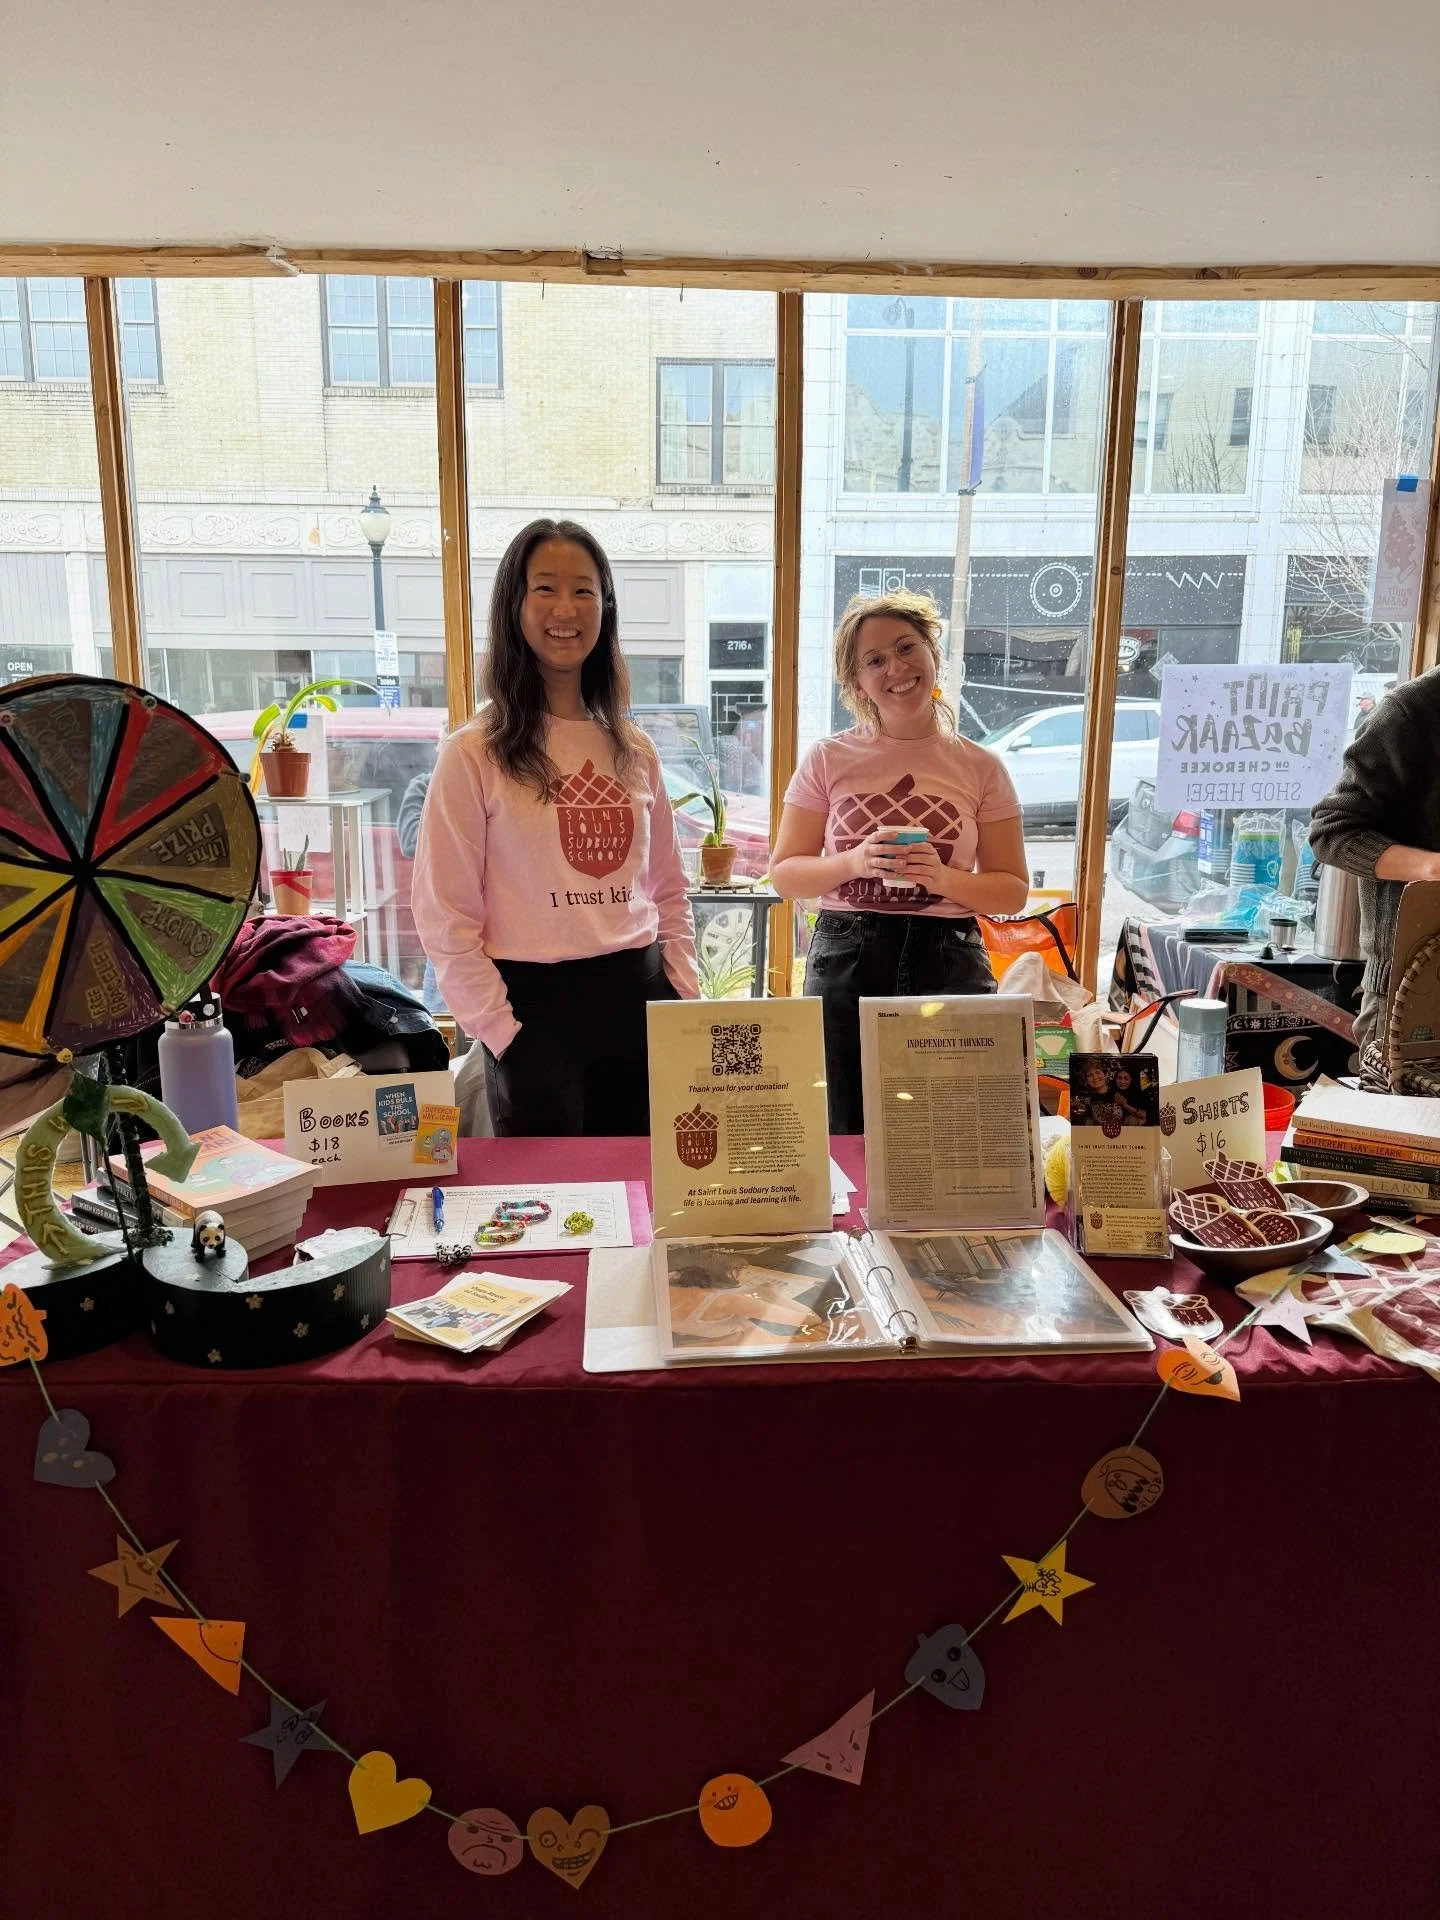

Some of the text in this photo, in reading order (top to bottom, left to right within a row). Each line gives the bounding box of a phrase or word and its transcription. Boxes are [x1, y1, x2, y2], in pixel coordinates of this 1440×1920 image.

[727, 640, 752, 650] 2716A
[7, 661, 33, 671] OPEN
[566, 809, 624, 821] SAINT
[568, 822, 625, 834] LOUIS
[151, 813, 217, 862] PRIZE
[568, 837, 627, 849] SUDBURY
[568, 850, 623, 862] SCHOOL
[550, 892, 559, 908] I
[565, 889, 604, 906] trust
[139, 903, 212, 957] QUOTE
[87, 989, 107, 1018] FREE
[907, 1037, 995, 1049] INDEPENDENT THINKERS
[688, 1082, 789, 1093] Thank you for your donation!
[378, 1096, 413, 1107] KIDS RULE
[385, 1091, 405, 1100] WHEN
[383, 1108, 412, 1118] SCHOOL
[390, 1103, 403, 1111] THE
[309, 1136, 341, 1153] $18
[1196, 1129, 1226, 1157] $16
[1306, 1137, 1346, 1150] DIFFERENT
[1350, 1142, 1369, 1153] WAY
[1376, 1145, 1401, 1158] LEARN
[311, 1154, 342, 1166] each
[687, 1184, 796, 1197] At Saint Louis Sudbury School,
[1371, 1180, 1424, 1194] LEARN
[683, 1194, 801, 1207] life is learning and learning is life.
